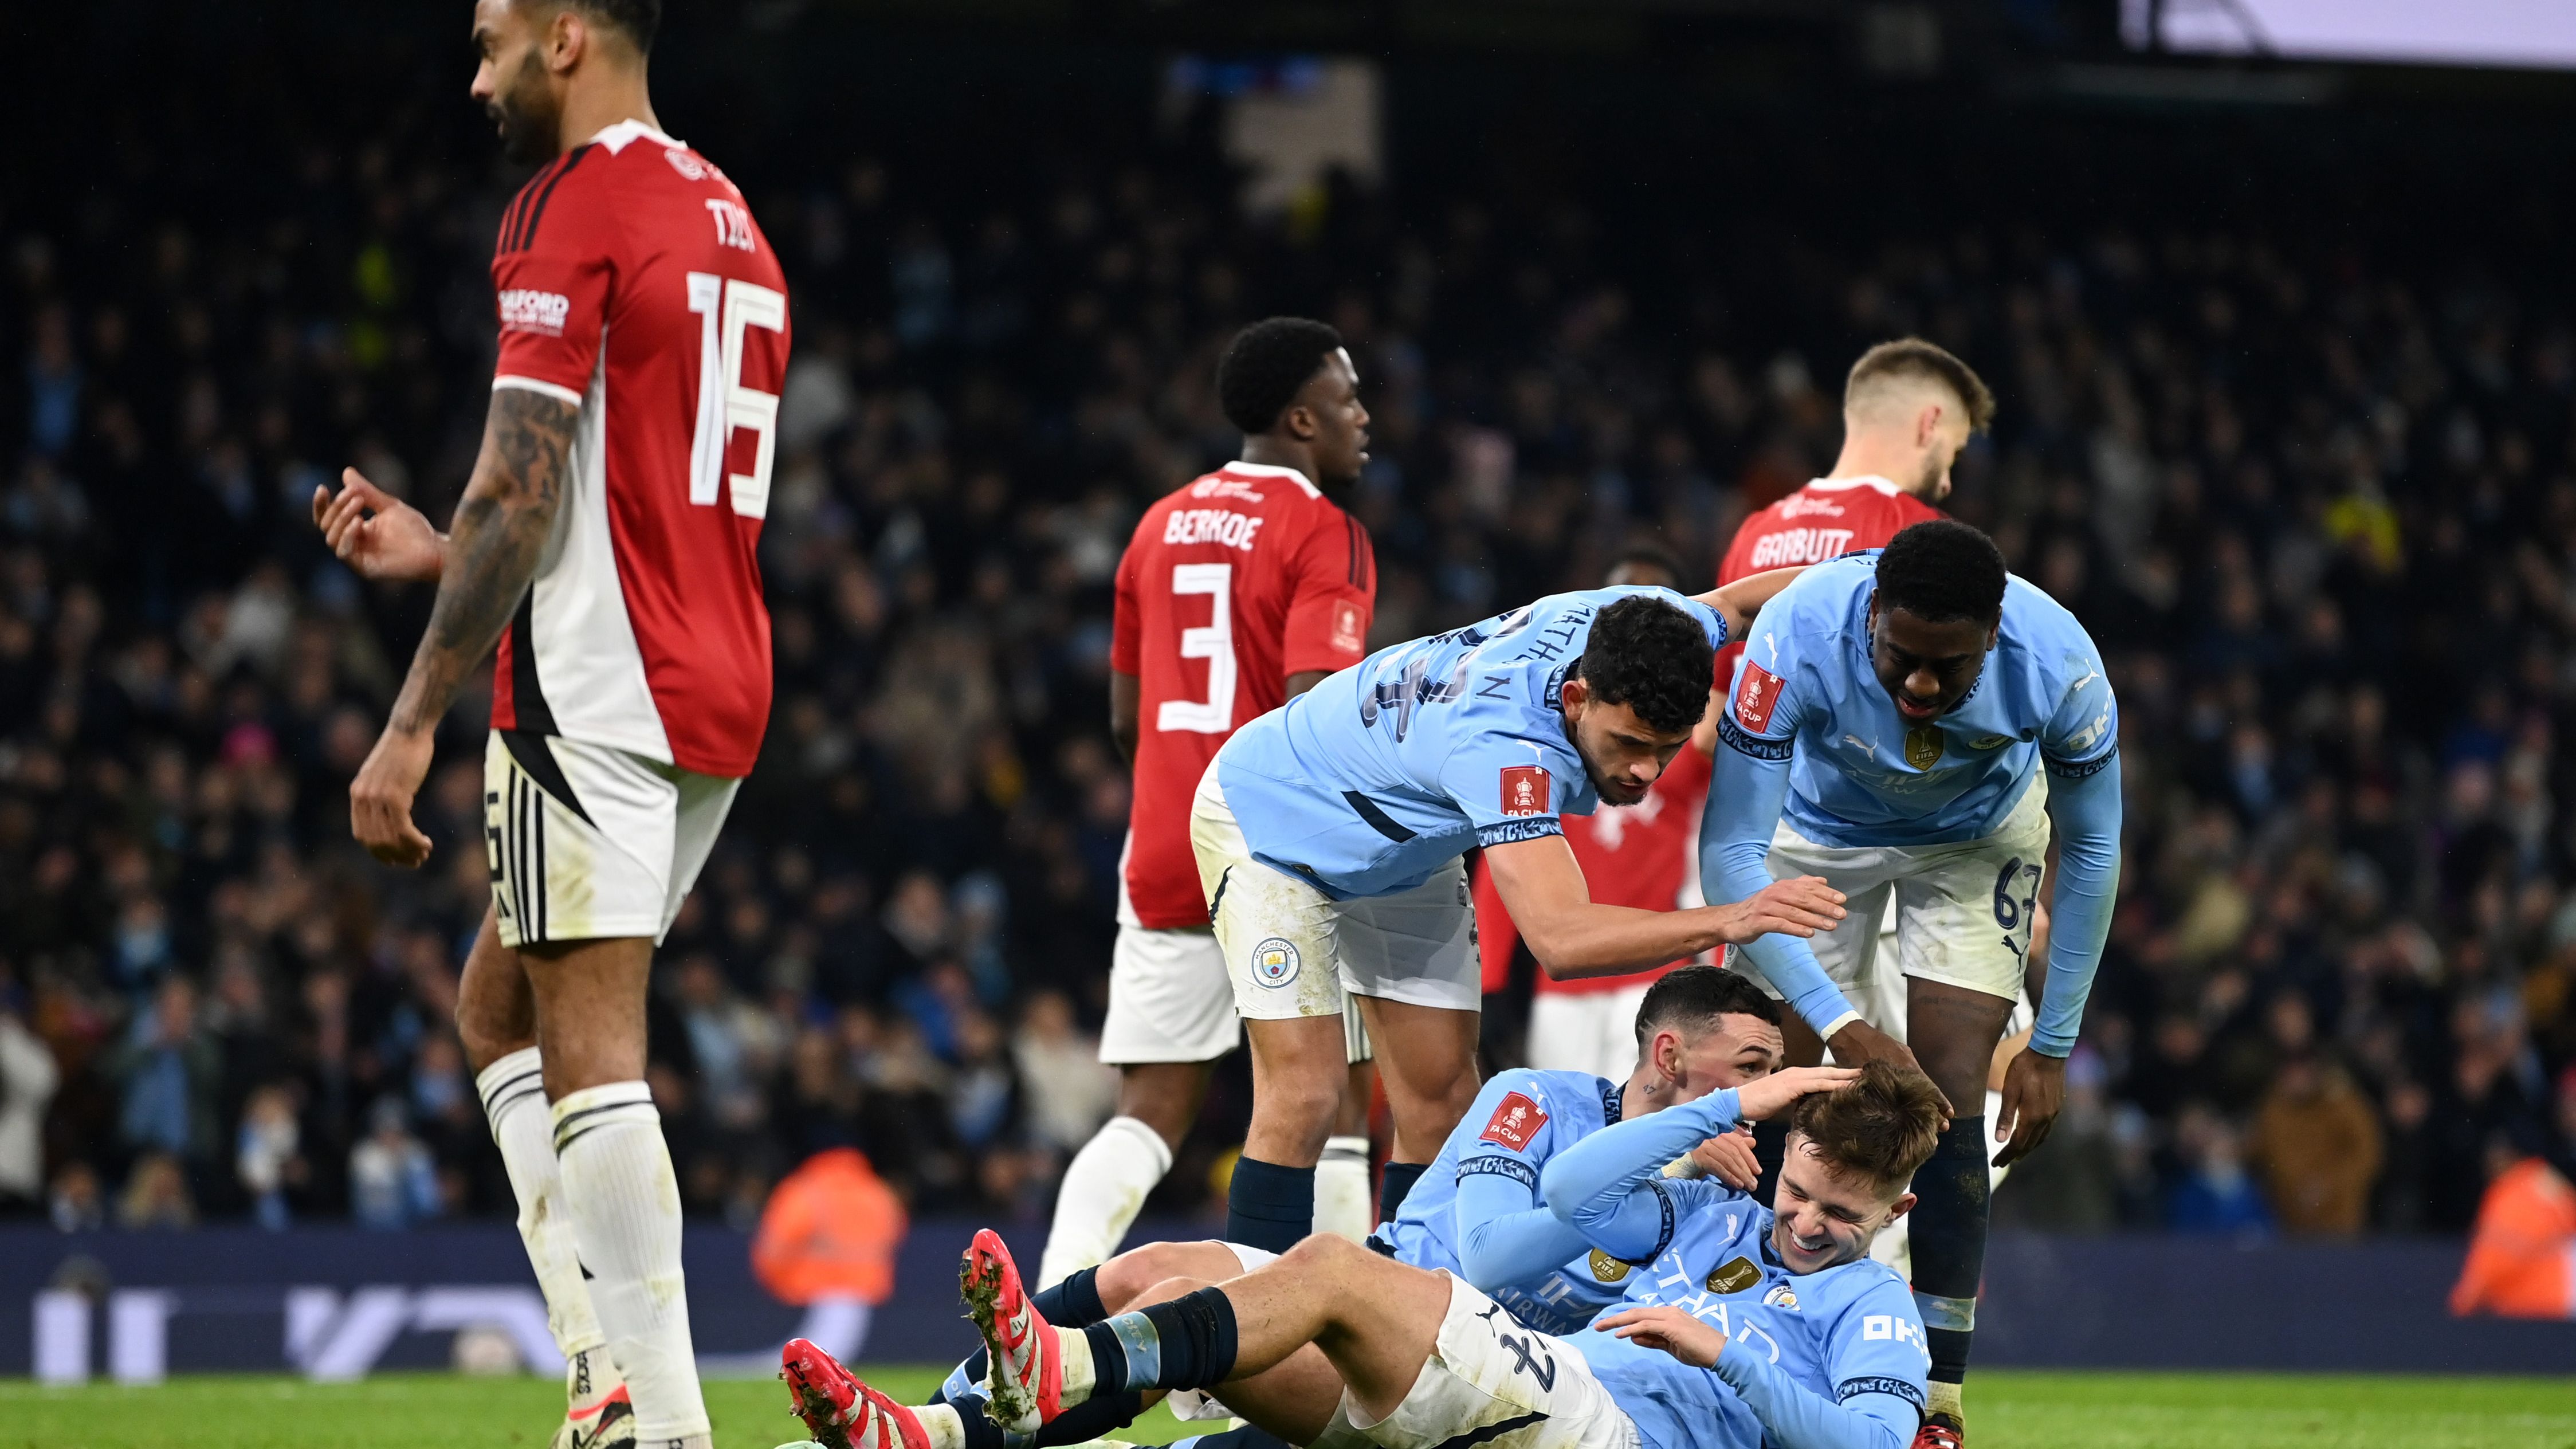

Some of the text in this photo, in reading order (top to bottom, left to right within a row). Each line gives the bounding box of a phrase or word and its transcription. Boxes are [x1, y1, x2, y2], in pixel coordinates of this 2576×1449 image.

[1163, 509, 1263, 551] BERKOE
[1751, 527, 1855, 569] GARBUTT
[1156, 563, 1238, 735] 3
[1736, 701, 1762, 722] FA CUP
[1916, 751, 1934, 760] FIFA
[1993, 857, 2043, 940] 67
[1255, 941, 1294, 960] MANCHESTER
[1490, 1125, 1522, 1142] FA CUP
[1596, 1261, 1614, 1276] FIFA
[1714, 1279, 1729, 1291] FIFA
